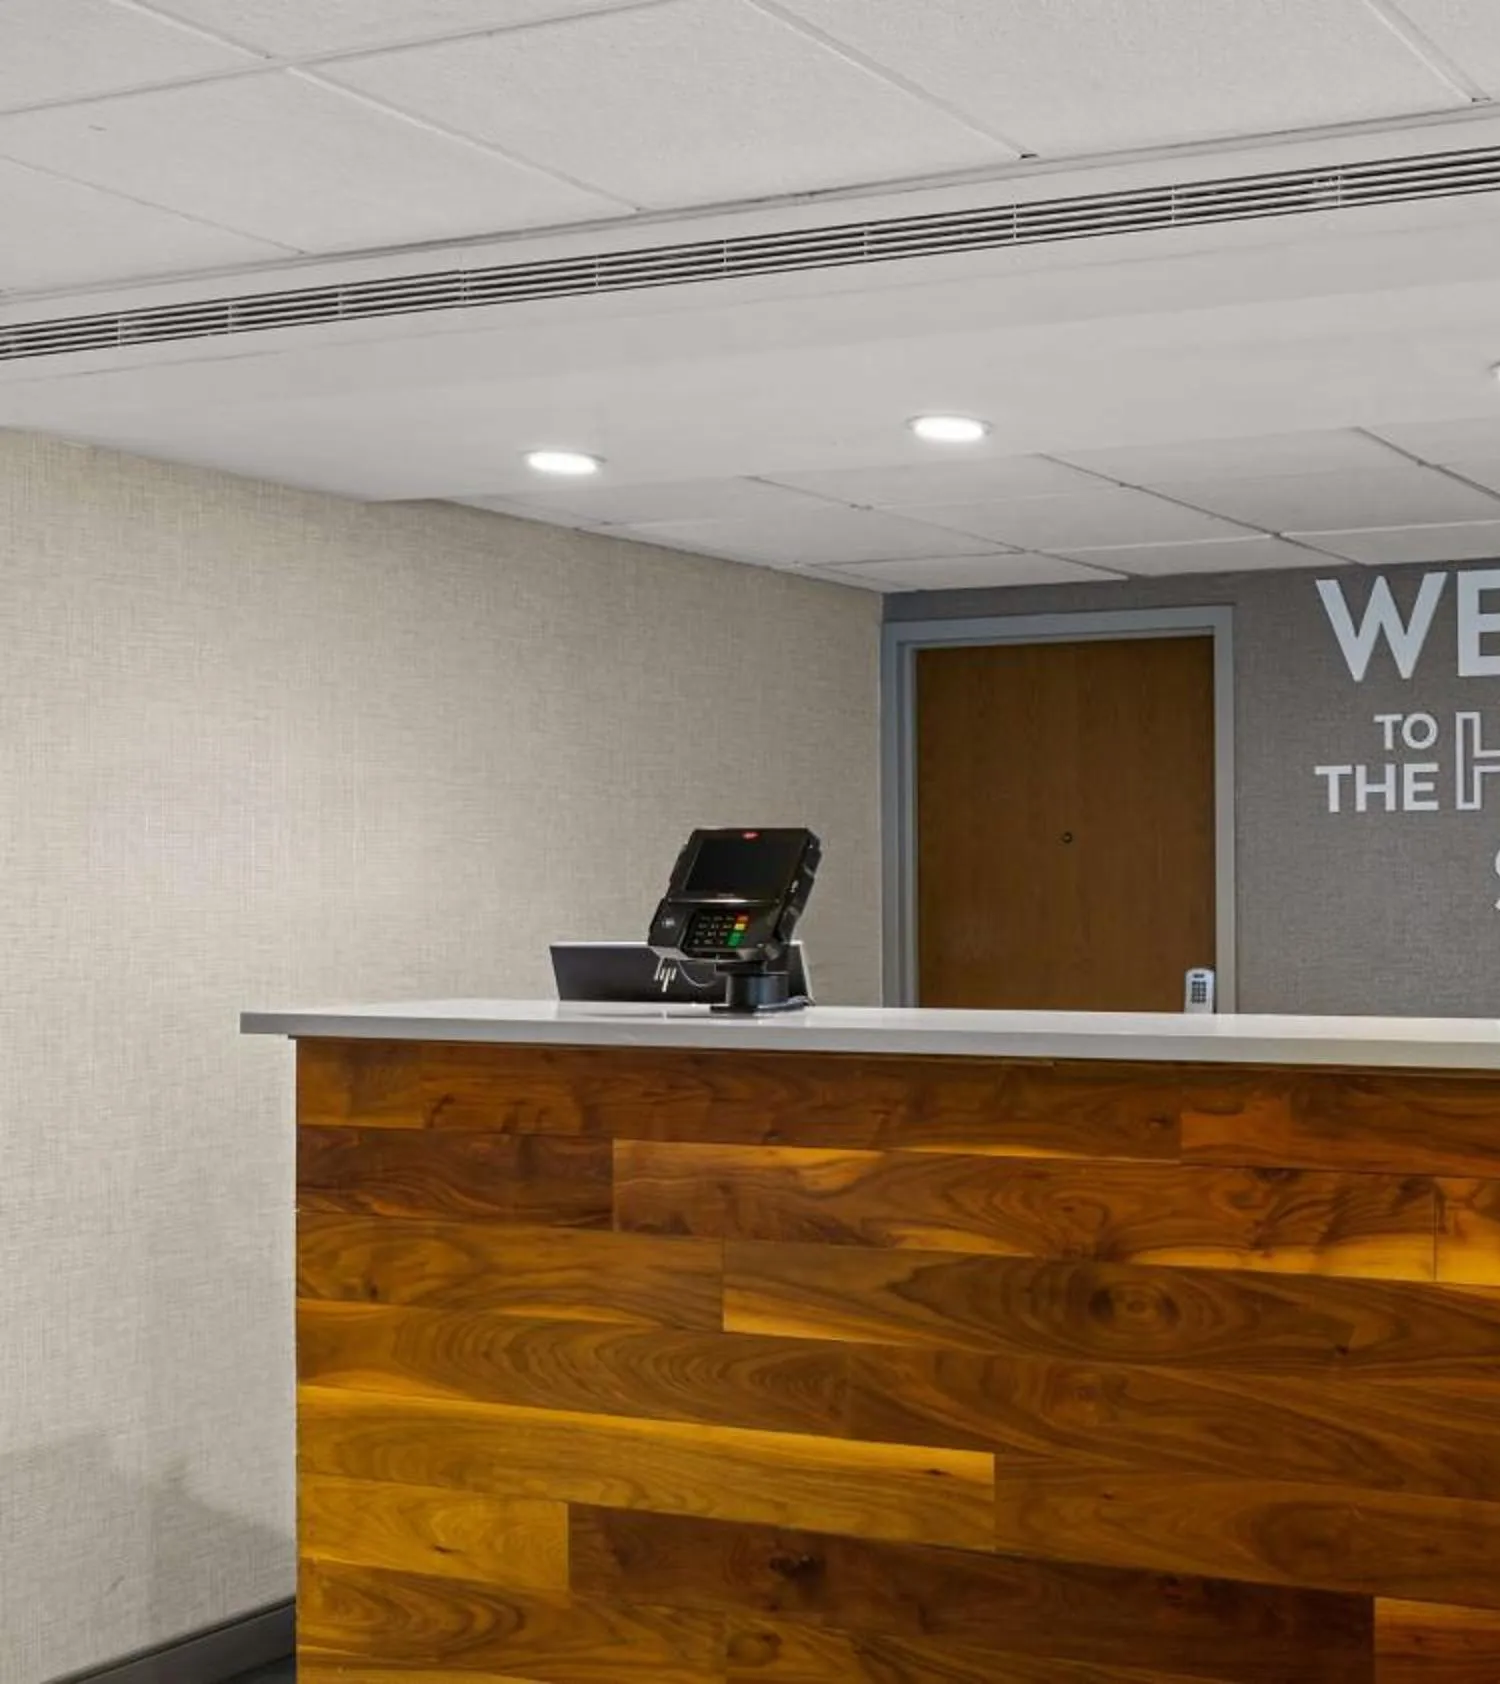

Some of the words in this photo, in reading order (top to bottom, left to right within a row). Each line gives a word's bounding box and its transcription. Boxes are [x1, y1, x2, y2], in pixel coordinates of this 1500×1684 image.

[1374, 712, 1438, 751] TO
[1315, 762, 1438, 812] THE
[653, 958, 677, 993] hp
